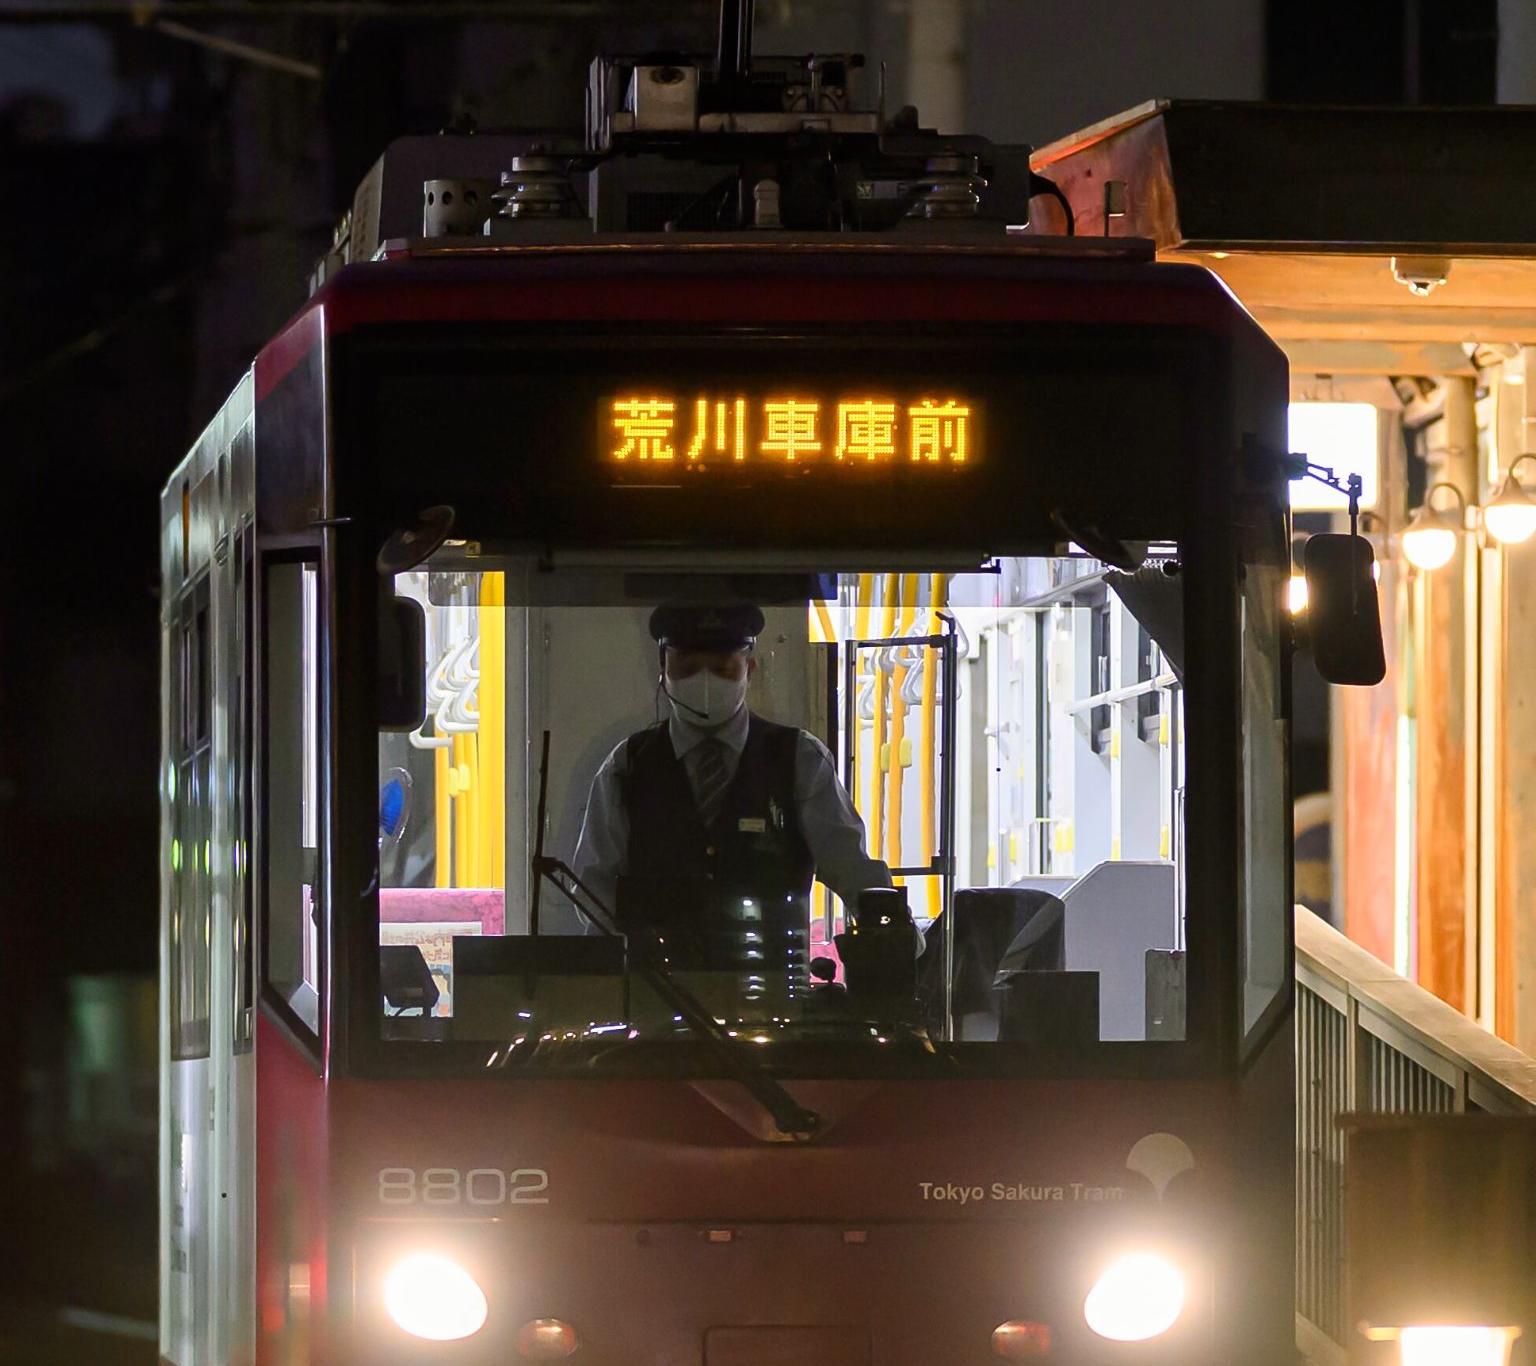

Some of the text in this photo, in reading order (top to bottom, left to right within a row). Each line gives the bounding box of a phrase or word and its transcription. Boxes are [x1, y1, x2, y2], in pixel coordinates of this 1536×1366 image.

[613, 399, 969, 461] 荒川車庫前
[378, 1167, 550, 1205] 8802
[919, 1182, 1123, 1205] Tokyo Sakura Tram
